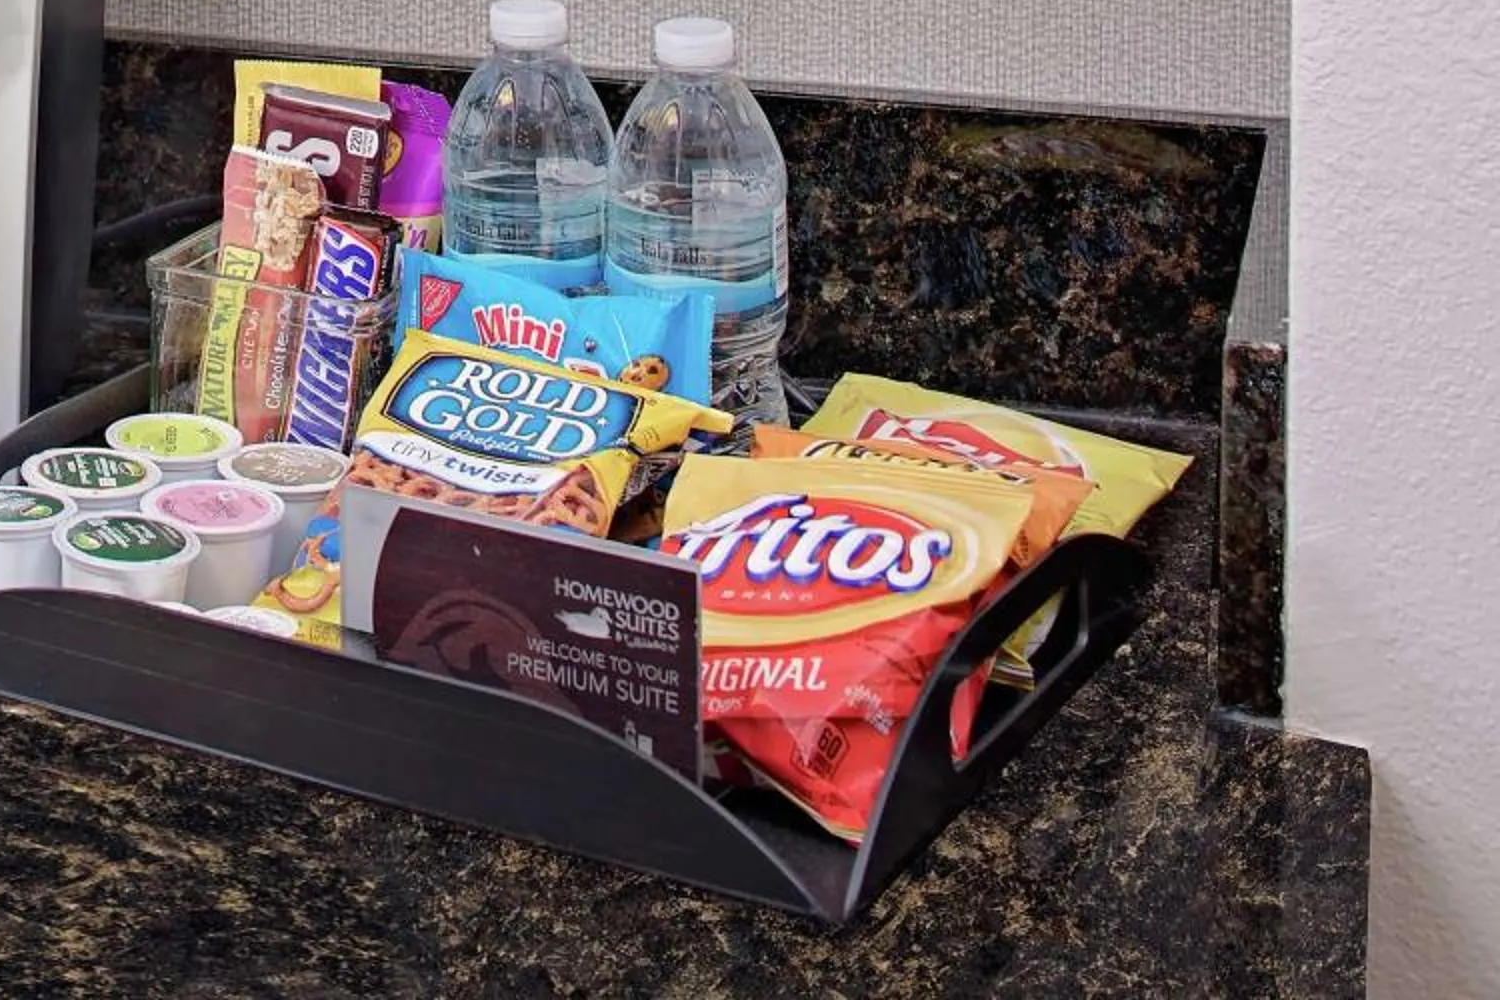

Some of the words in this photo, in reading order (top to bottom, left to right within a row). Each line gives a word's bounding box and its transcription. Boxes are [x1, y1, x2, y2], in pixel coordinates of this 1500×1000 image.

[349, 129, 364, 153] 220
[287, 226, 378, 450] NICKERS
[472, 304, 567, 362] Mini
[202, 338, 229, 421] NATURE
[447, 358, 609, 420] ROLD
[407, 387, 598, 459] GOLD
[390, 437, 445, 468] tiny
[443, 456, 541, 487] twists
[553, 576, 680, 621] HOMEWOOD
[614, 610, 680, 641] SUITES
[507, 652, 609, 697] PREMIUM
[615, 679, 679, 715] SUITE
[526, 635, 606, 670] WELCOME
[608, 655, 633, 675] TO
[635, 661, 679, 687] YOUR
[701, 656, 827, 691] IGINAL
[817, 727, 843, 760] 60
